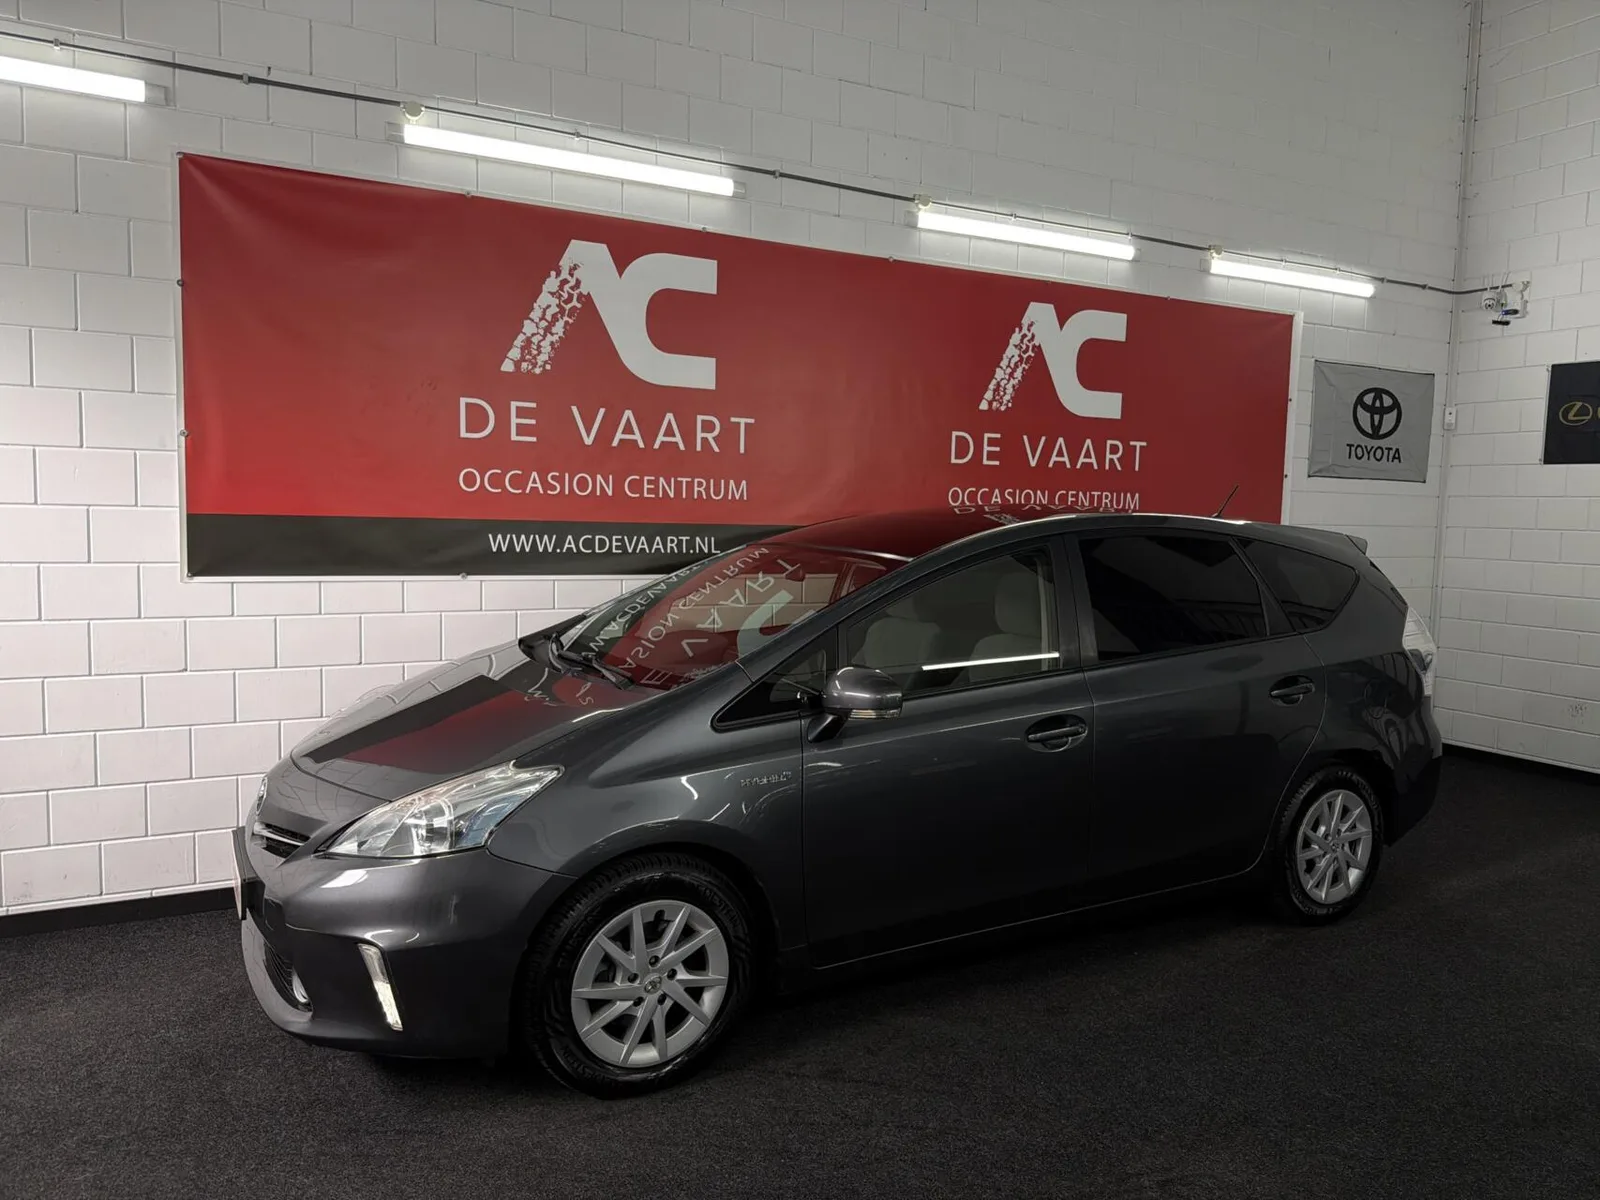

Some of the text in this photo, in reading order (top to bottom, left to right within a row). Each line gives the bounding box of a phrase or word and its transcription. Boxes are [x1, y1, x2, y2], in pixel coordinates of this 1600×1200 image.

[459, 396, 756, 454] DE VAART
[950, 431, 1147, 472] DE VAART
[1345, 443, 1402, 464] TOYOTA
[458, 467, 748, 501] OCCASION CENTRUM
[948, 487, 1049, 507] OCCASION
[1055, 490, 1140, 511] CENTRUM
[488, 533, 721, 554] WWW.ACDEVAART.NL
